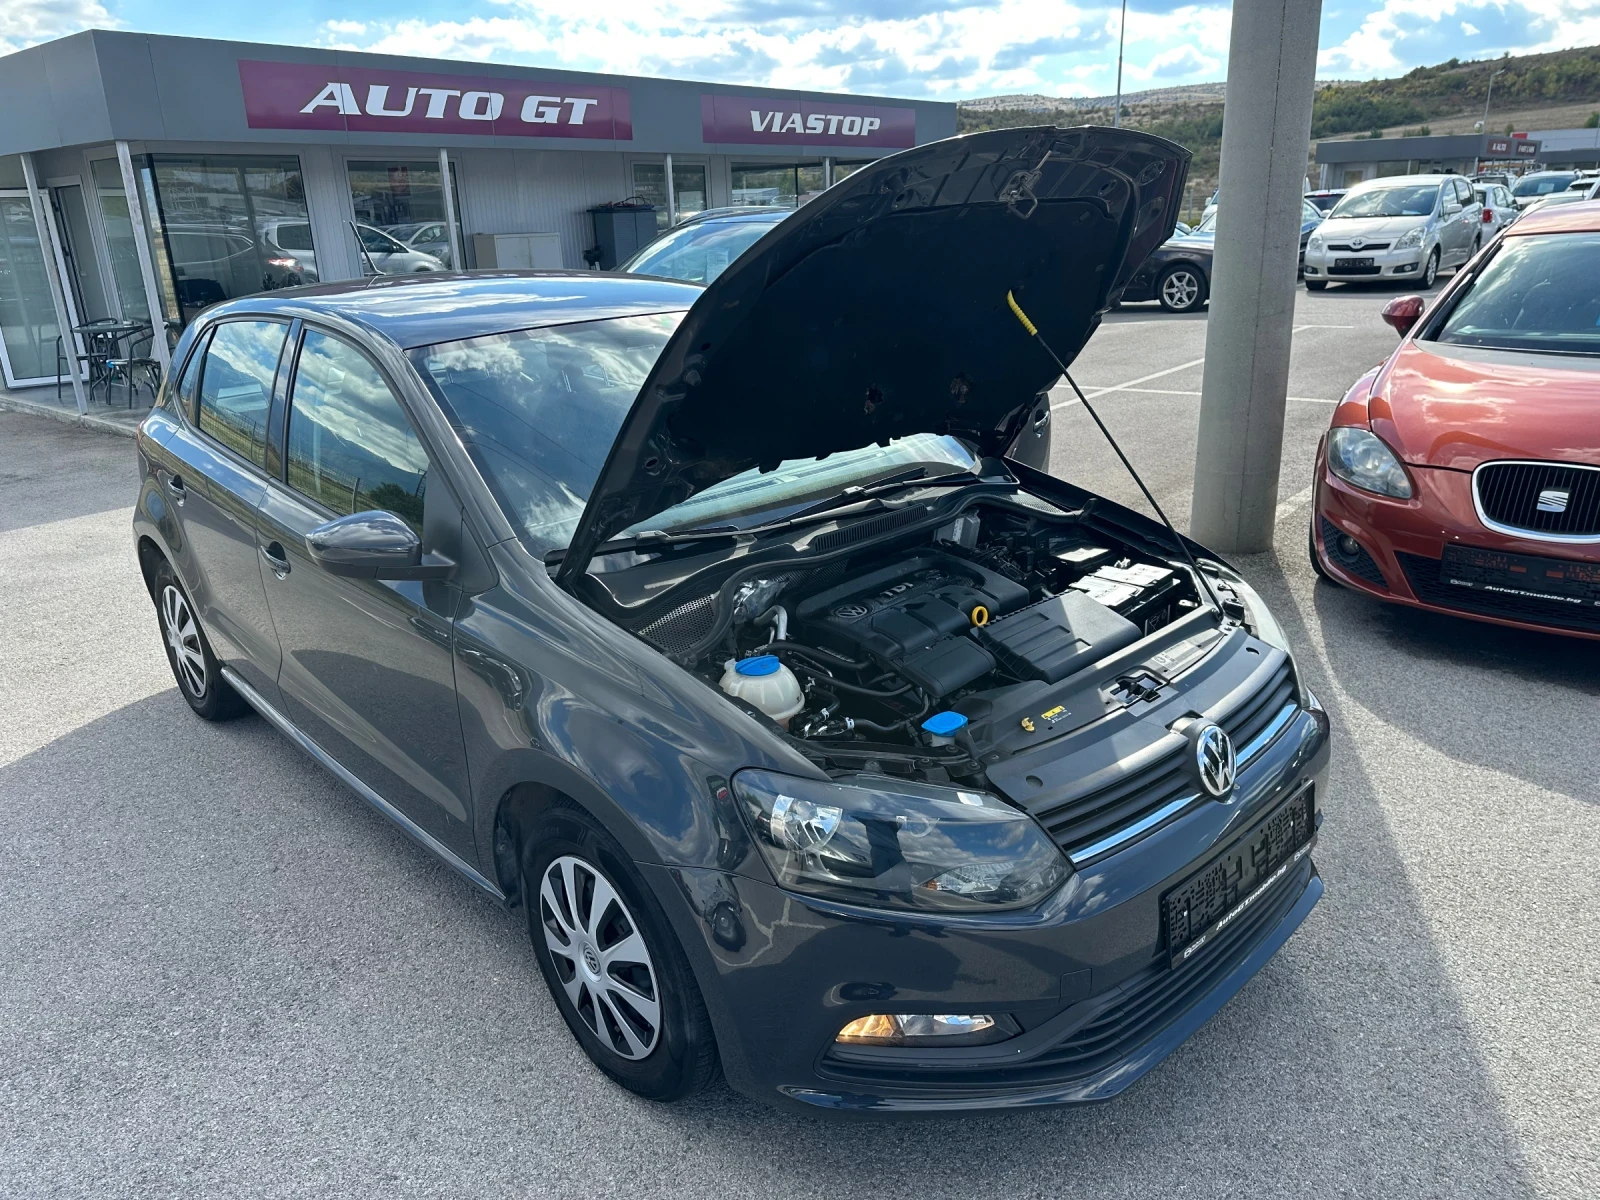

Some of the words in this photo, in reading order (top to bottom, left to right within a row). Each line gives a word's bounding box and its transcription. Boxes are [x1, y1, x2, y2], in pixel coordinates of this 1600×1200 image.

[300, 82, 504, 121] AUTO
[520, 95, 598, 125] GT
[750, 110, 881, 136] VIASTOP
[880, 582, 914, 596] TDI
